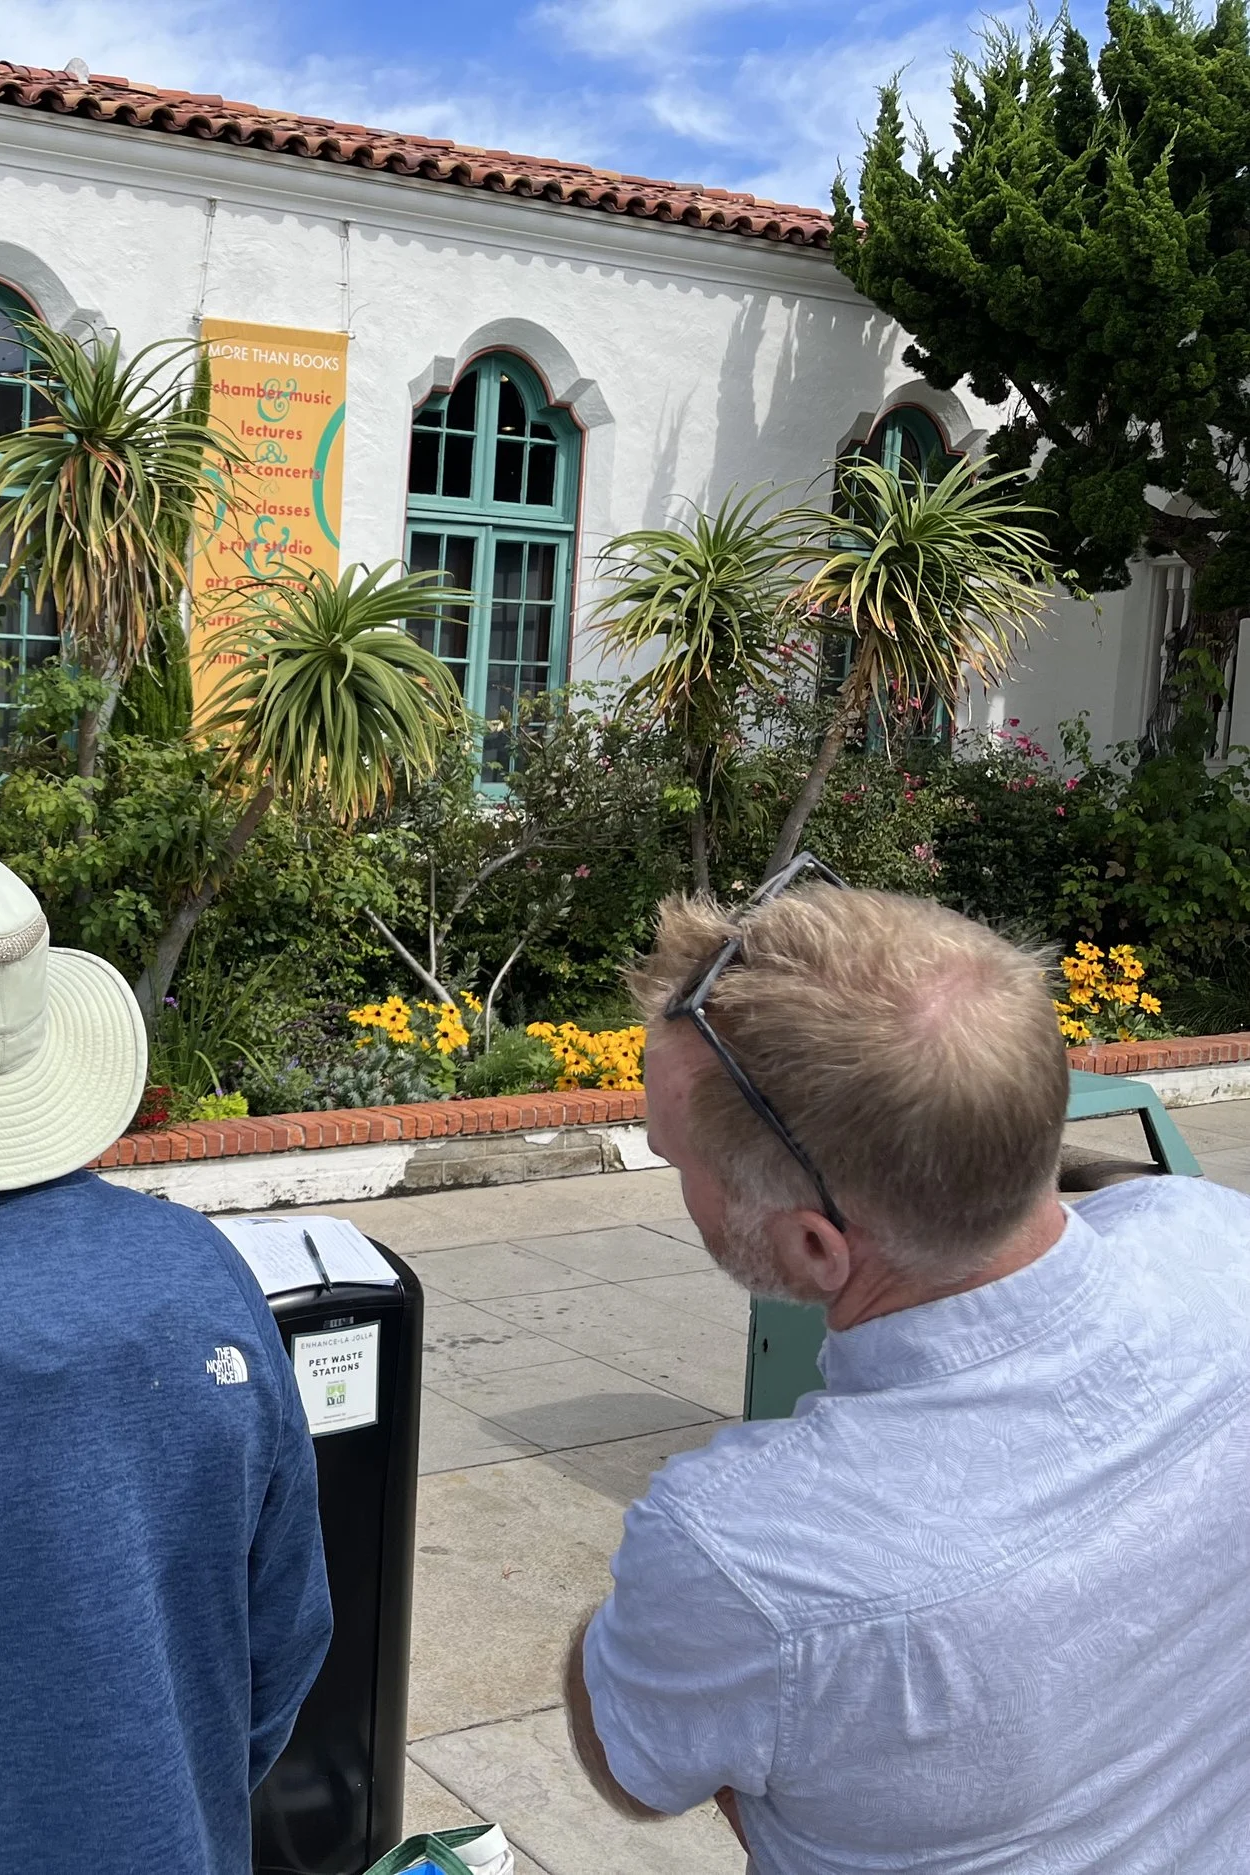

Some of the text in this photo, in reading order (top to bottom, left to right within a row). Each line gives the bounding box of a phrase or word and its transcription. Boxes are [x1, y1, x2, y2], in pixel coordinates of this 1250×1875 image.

[208, 344, 339, 371] MORE THAN BOOKS
[213, 379, 332, 405] chamber music
[241, 420, 303, 440] lectures
[256, 464, 321, 480] concerts
[256, 500, 310, 517] classes
[220, 536, 312, 555] print studio
[205, 576, 229, 588] art
[352, 1332, 373, 1342] JOLLA
[215, 1347, 231, 1360] THE
[309, 1351, 363, 1367] PET WASTE
[206, 1360, 233, 1373] NORTH
[312, 1362, 359, 1377] STATIONS
[216, 1371, 236, 1385] FACE
